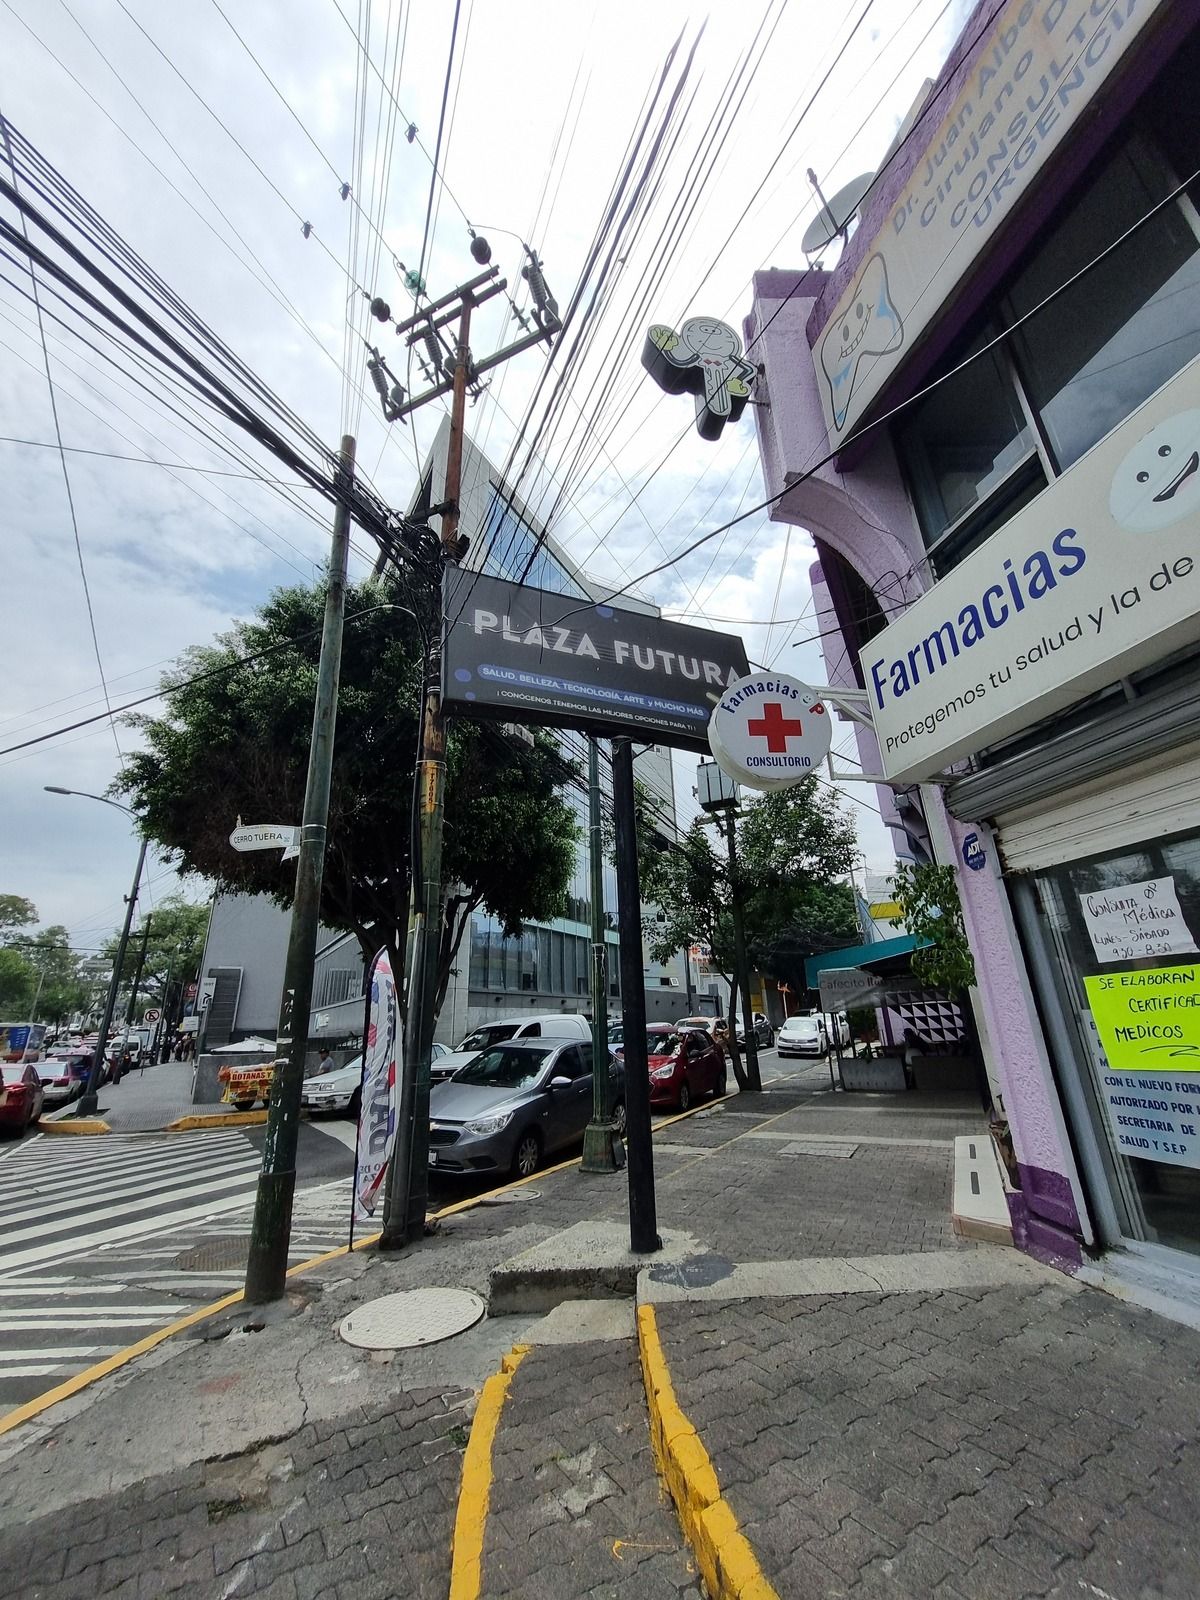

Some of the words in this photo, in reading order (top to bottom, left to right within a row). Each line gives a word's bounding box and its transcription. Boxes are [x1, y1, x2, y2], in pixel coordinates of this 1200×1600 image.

[972, 0, 1137, 228] URGENCI
[918, 50, 1034, 229] Cirujano
[922, 104, 973, 187] Juan
[870, 528, 1087, 710] Farmacias
[474, 608, 601, 660] PLAZA
[613, 639, 740, 687] FUTURA
[886, 681, 986, 753] Protegemos
[988, 664, 1012, 689] tu
[1015, 617, 1083, 672] salud
[1087, 606, 1104, 634] y
[1110, 586, 1141, 615] la
[1149, 555, 1194, 592] de
[624, 694, 645, 706] ARTE
[654, 700, 686, 714] MUCHO
[720, 680, 799, 714] Farmacias
[588, 705, 602, 715] LAS
[746, 756, 811, 767] CONSULTORIO
[968, 841, 980, 858] ADT
[1099, 978, 1114, 990] SE
[1121, 970, 1195, 986] ELABORAN
[232, 1070, 265, 1080] BOTANAS
[1105, 1076, 1123, 1087] CON
[1125, 1078, 1136, 1088] EL
[1138, 1079, 1172, 1091] NUEVO
[1110, 1095, 1168, 1111] AUTORIZADO
[1171, 1102, 1194, 1115] POR
[1117, 1114, 1174, 1133] SECRETARIA
[1180, 1124, 1197, 1136] DE
[1119, 1134, 1149, 1149] SALUD
[1151, 1140, 1159, 1151] Y
